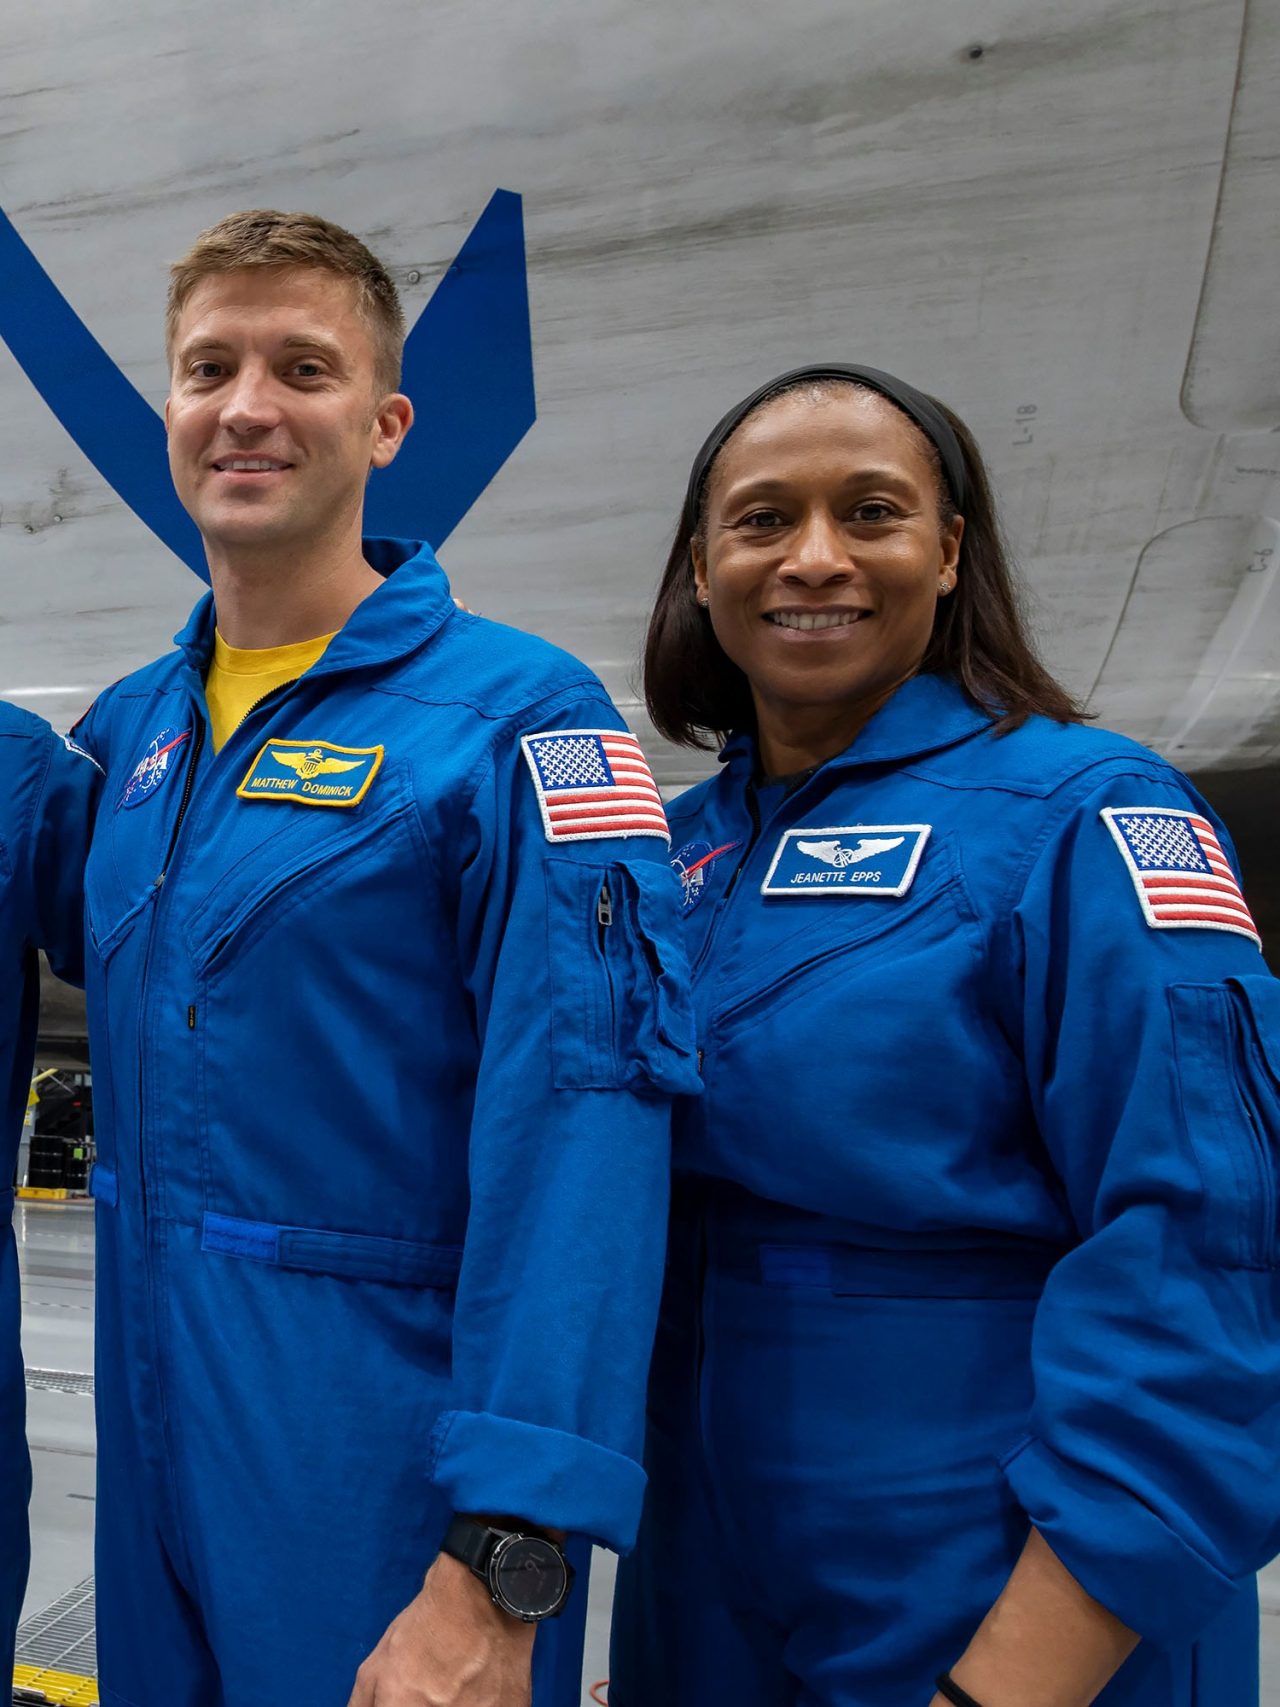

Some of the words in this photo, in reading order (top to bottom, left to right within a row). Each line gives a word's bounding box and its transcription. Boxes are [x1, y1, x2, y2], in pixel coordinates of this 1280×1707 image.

[1012, 404, 1038, 446] L-18
[251, 778, 298, 789] MATTHEW
[302, 781, 353, 796] DOMINICK
[790, 871, 846, 884] JEANETTE
[850, 871, 882, 882] EPPS
